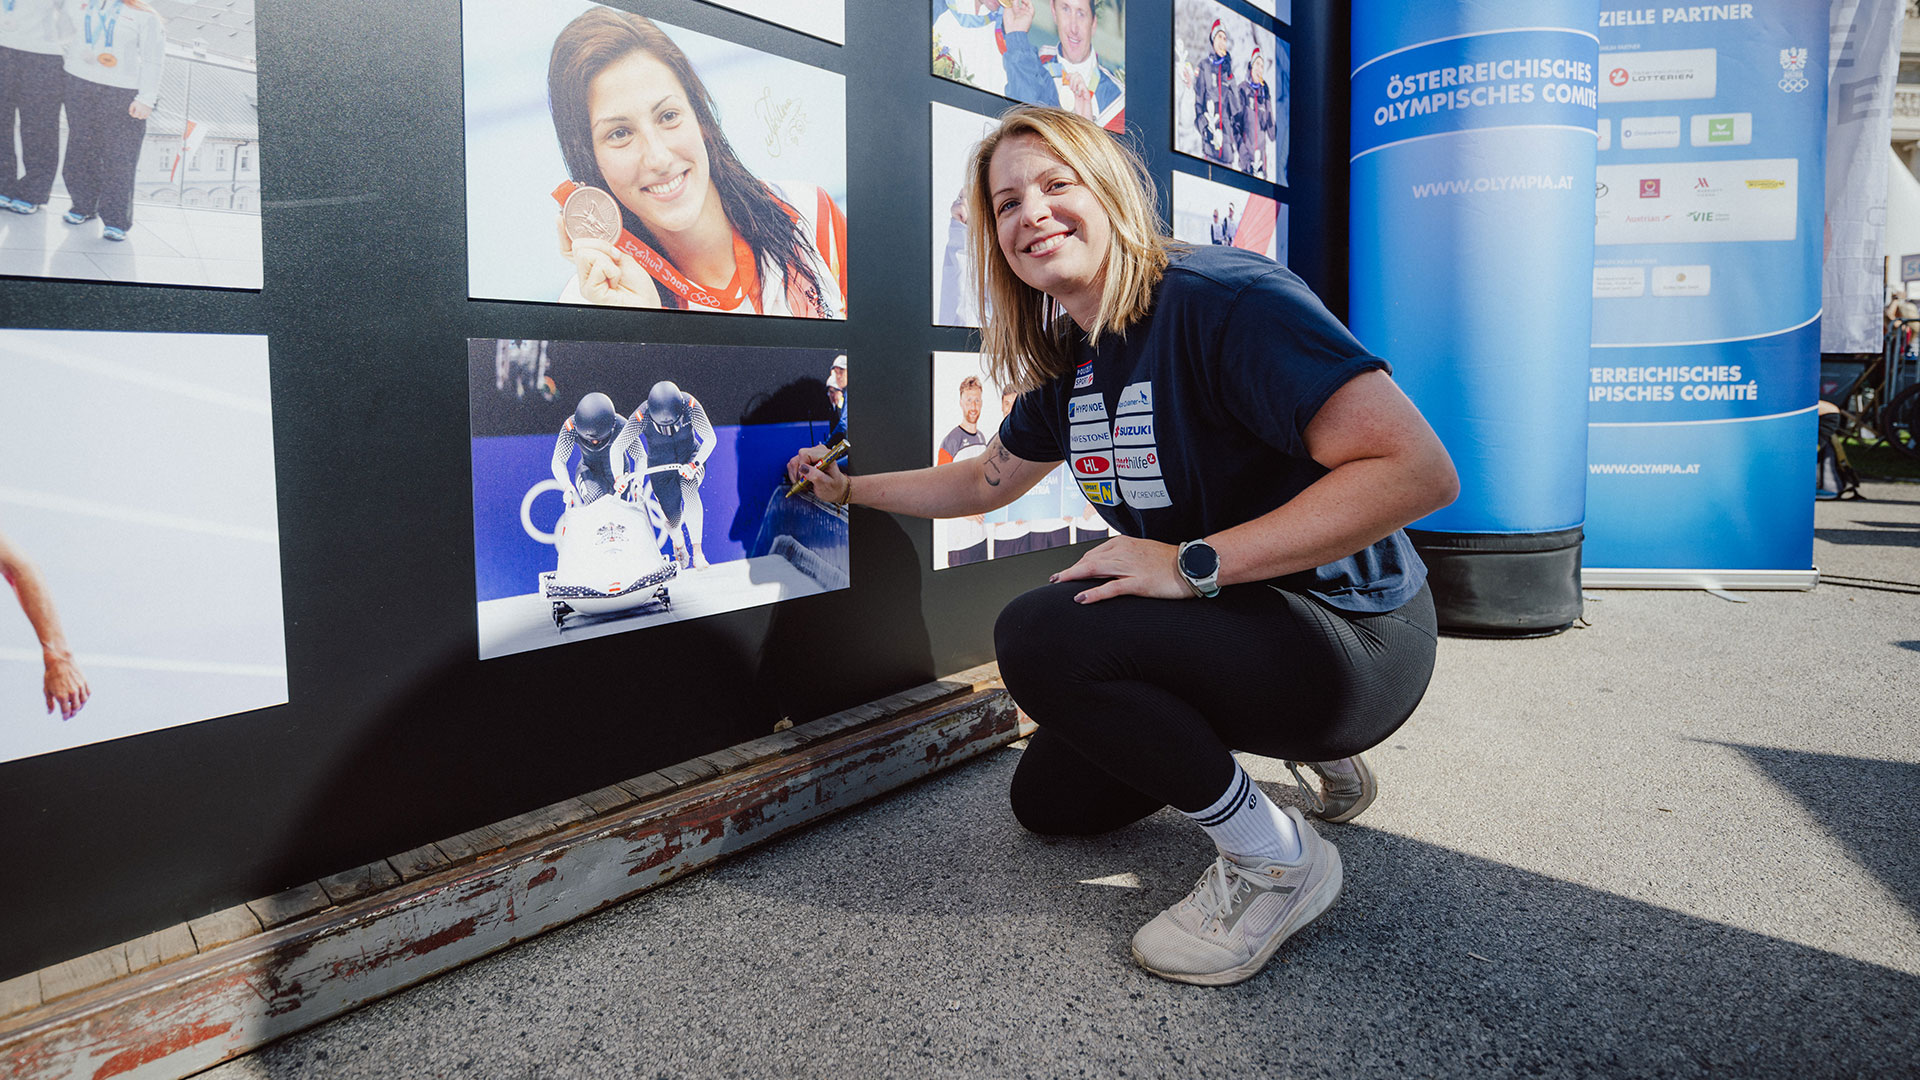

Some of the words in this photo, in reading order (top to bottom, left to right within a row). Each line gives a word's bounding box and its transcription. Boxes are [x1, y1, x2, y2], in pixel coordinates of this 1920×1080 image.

[1662, 3, 1753, 24] PARTNER
[1386, 59, 1592, 100] ÖSTERREICHISCHES
[1632, 73, 1694, 82] LOTTERIEN
[1373, 83, 1535, 126] OLYMPISCHES
[1542, 84, 1597, 110] COMITÉ
[1412, 175, 1574, 199] WWW.OLYMPIA.AT
[1680, 379, 1758, 401] COMITÉ
[1088, 402, 1105, 412] NOE
[1119, 425, 1152, 436] SUZUKI
[1083, 458, 1100, 472] HL
[1589, 464, 1701, 475] WWW.OLYMPIA.AT
